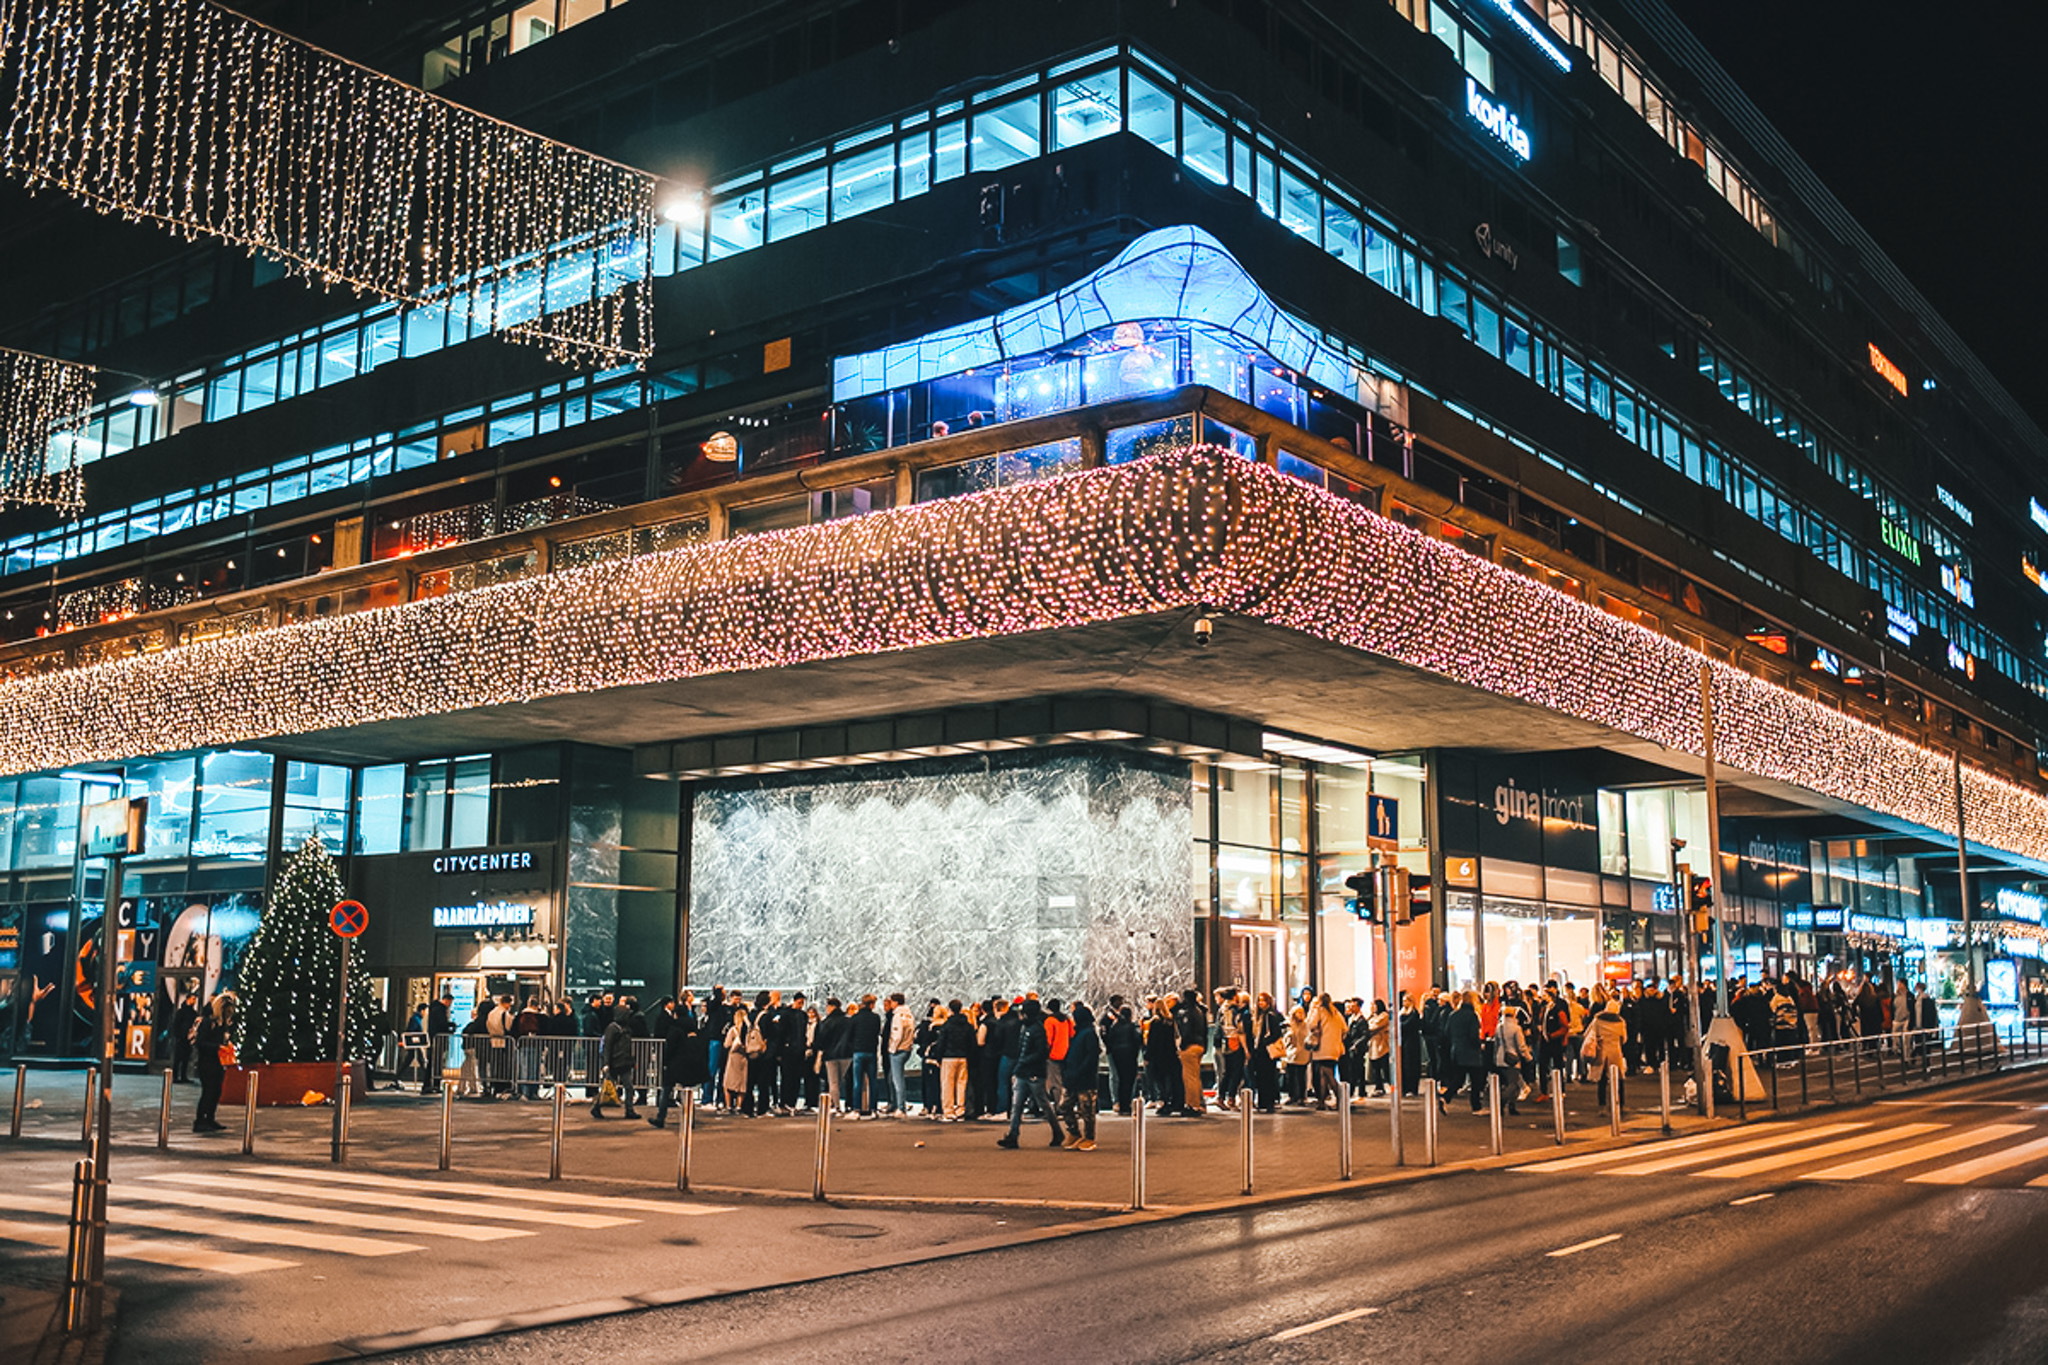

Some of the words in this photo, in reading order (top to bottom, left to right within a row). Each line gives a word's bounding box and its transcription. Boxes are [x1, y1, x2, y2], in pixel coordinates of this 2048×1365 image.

[1466, 77, 1530, 160] korkia
[1493, 239, 1518, 270] unity
[1881, 516, 1921, 567] ELIXIA
[1495, 778, 1540, 825] gina
[433, 851, 531, 873] CITYCENTER
[1460, 861, 1470, 876] 6
[433, 901, 531, 928] BAARIKÄRPÄNEN
[1397, 946, 1417, 960] nal
[1397, 963, 1416, 979] ale
